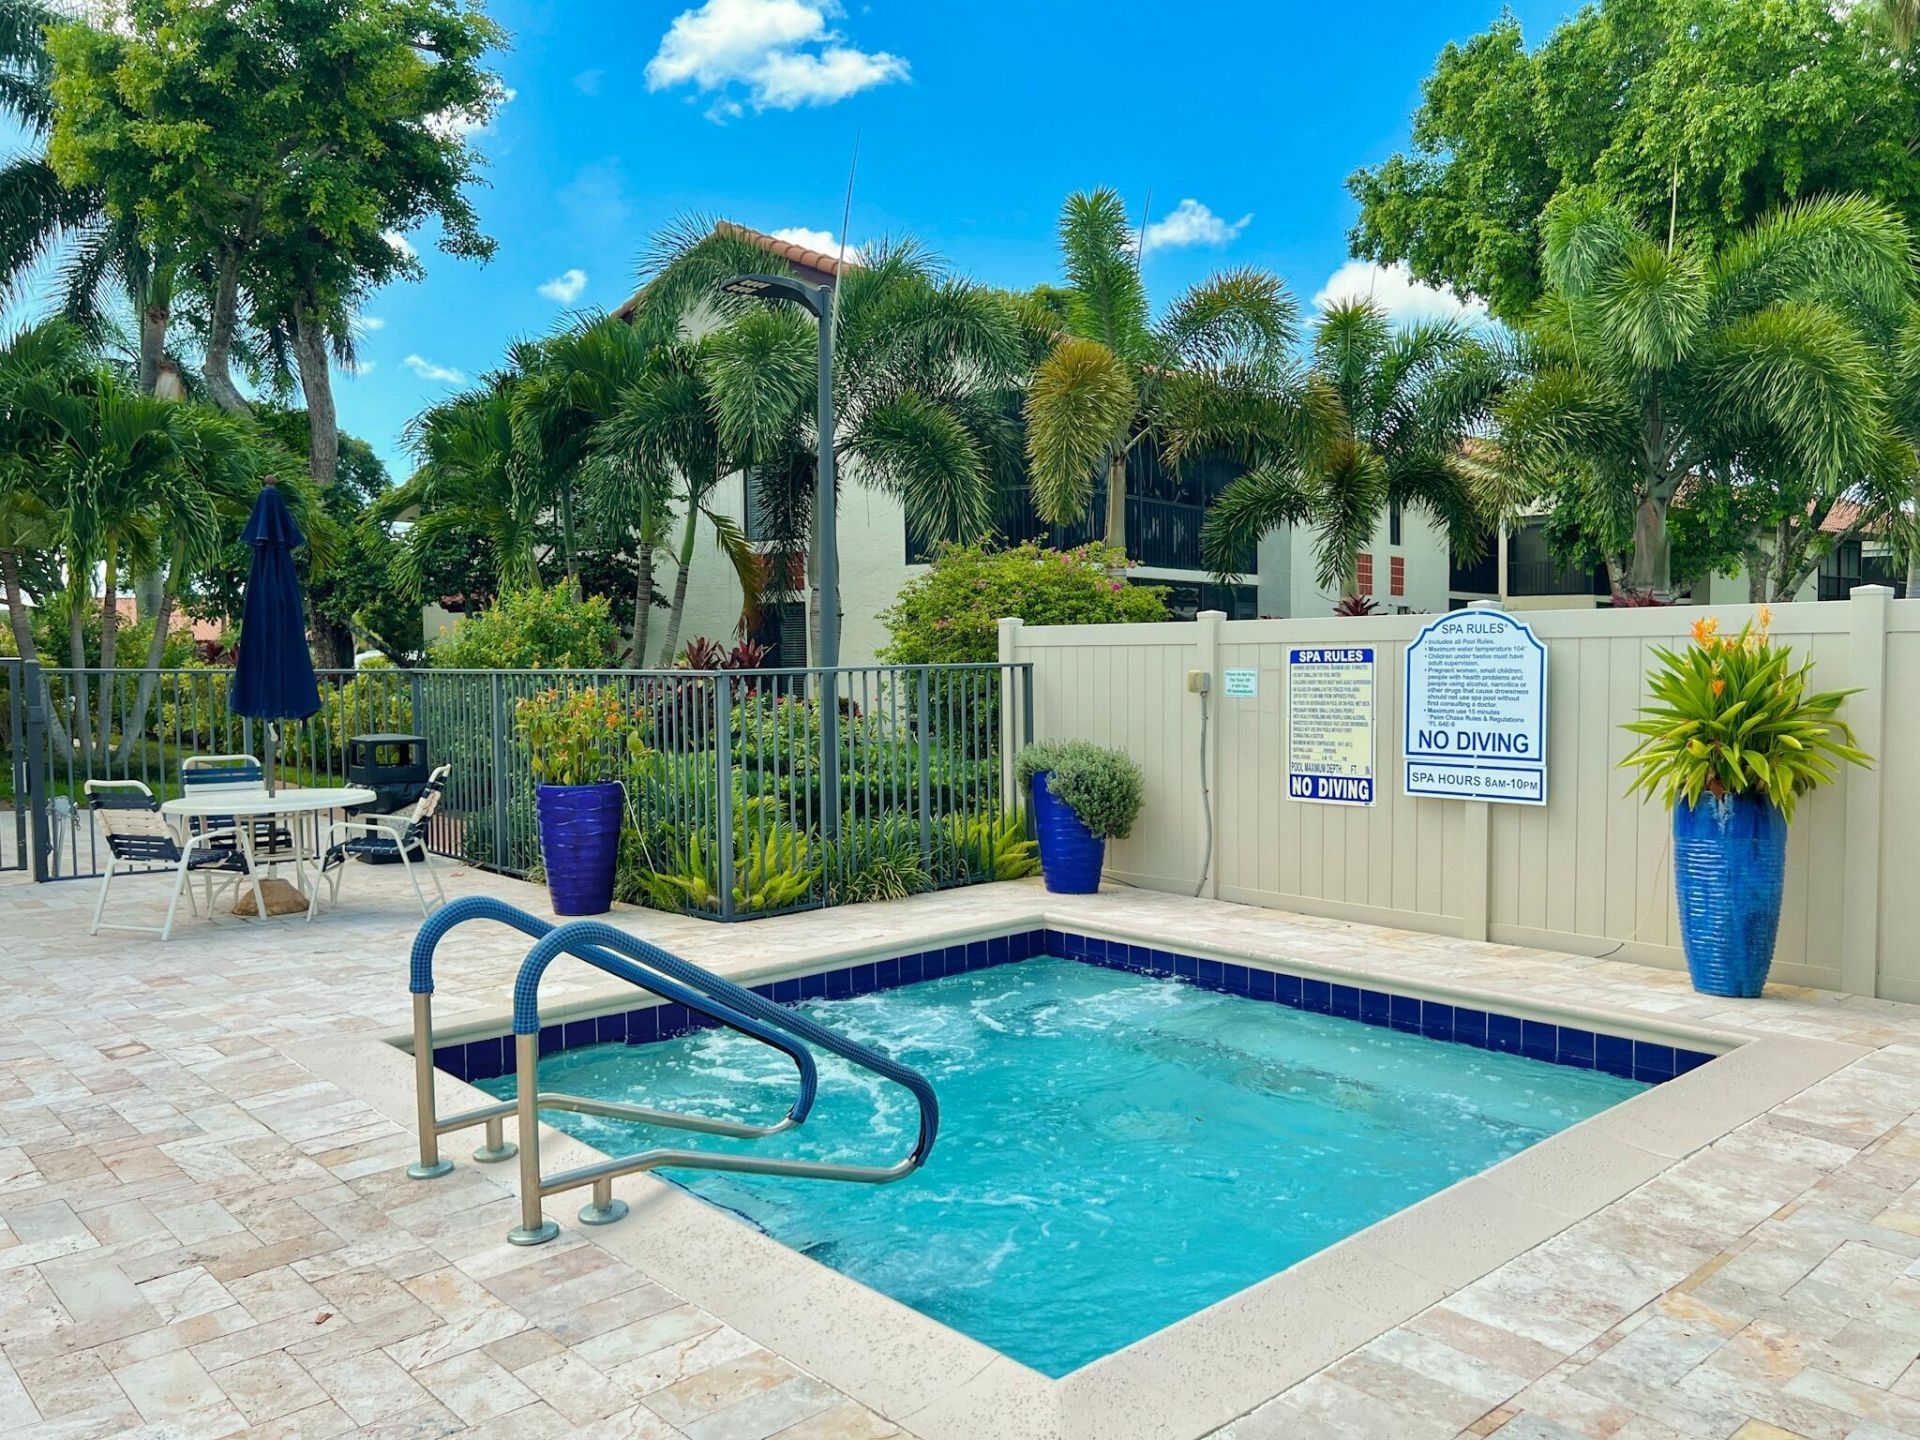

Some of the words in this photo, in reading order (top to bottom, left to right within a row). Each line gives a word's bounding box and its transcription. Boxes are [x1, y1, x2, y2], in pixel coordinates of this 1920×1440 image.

[1441, 624, 1463, 634] SPA
[1299, 651, 1320, 662] SPA
[1324, 650, 1364, 662] RULES
[1428, 667, 1454, 675] Pregnant
[1428, 681, 1448, 689] people
[1444, 688, 1462, 696] drugs
[1489, 716, 1524, 724] Regulations
[1418, 730, 1449, 750] NO
[1456, 731, 1529, 754] DIVING
[1292, 762, 1304, 772] POOL
[1304, 763, 1326, 773] MAXIMUM
[1326, 764, 1342, 774] DEPTH
[1412, 772, 1434, 783] SPA
[1438, 774, 1480, 786] HOURS
[1292, 776, 1312, 796] NO
[1318, 778, 1370, 800] DIVING
